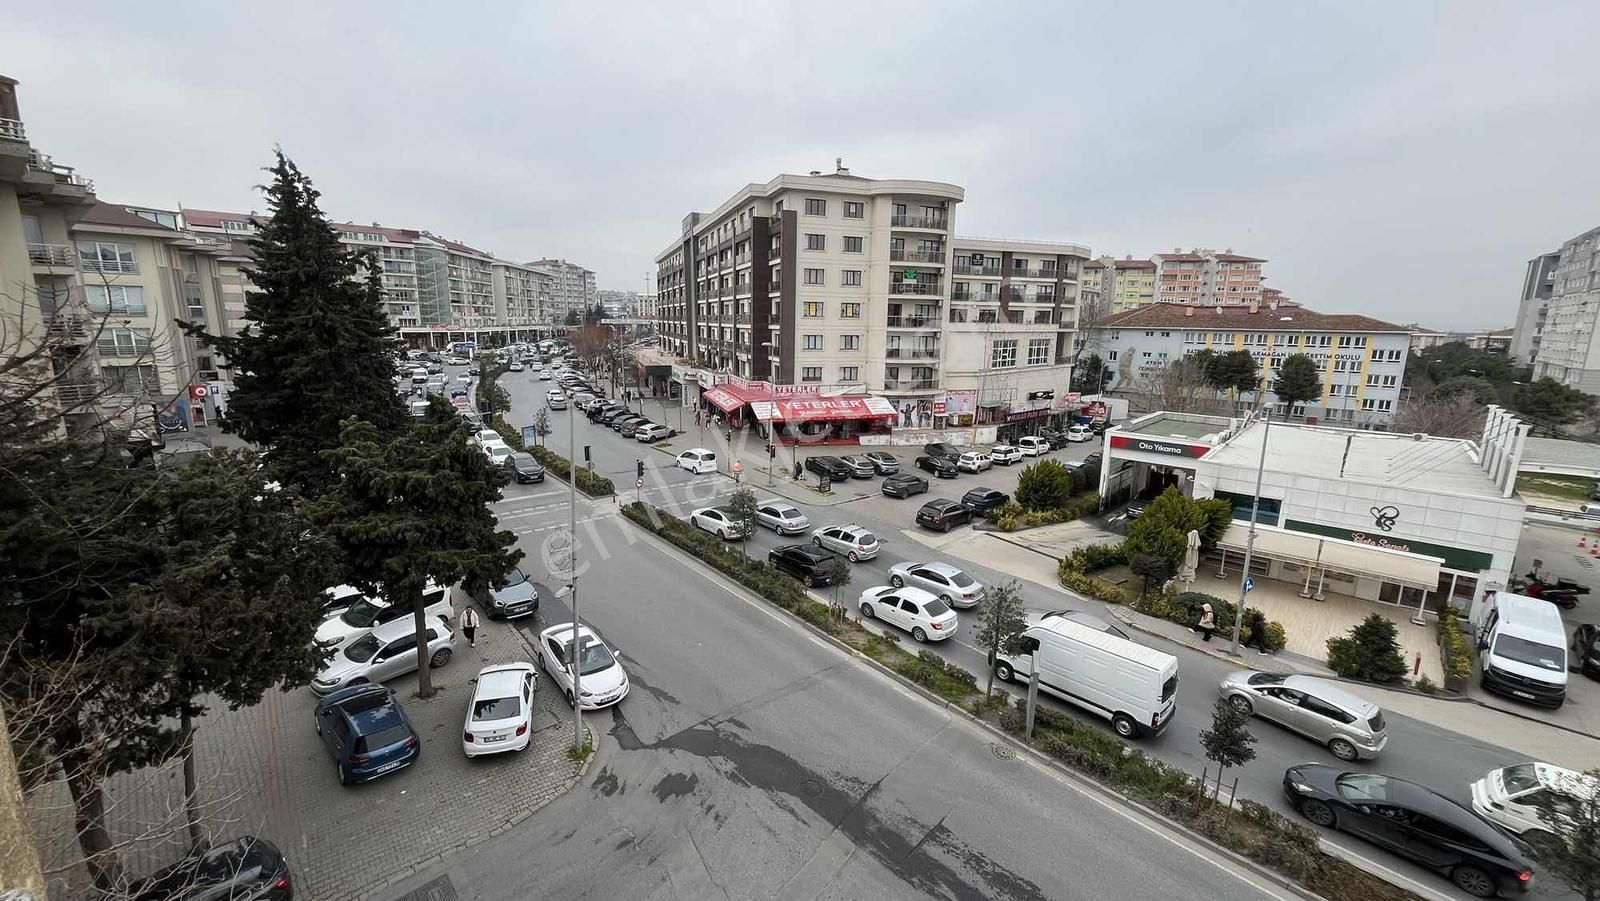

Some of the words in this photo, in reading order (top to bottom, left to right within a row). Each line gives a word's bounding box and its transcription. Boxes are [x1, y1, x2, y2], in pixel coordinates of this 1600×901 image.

[1334, 353, 1361, 361] OKULU
[777, 385, 818, 393] YETERLER
[781, 399, 862, 410] YETERLER
[1138, 442, 1153, 450] Oto
